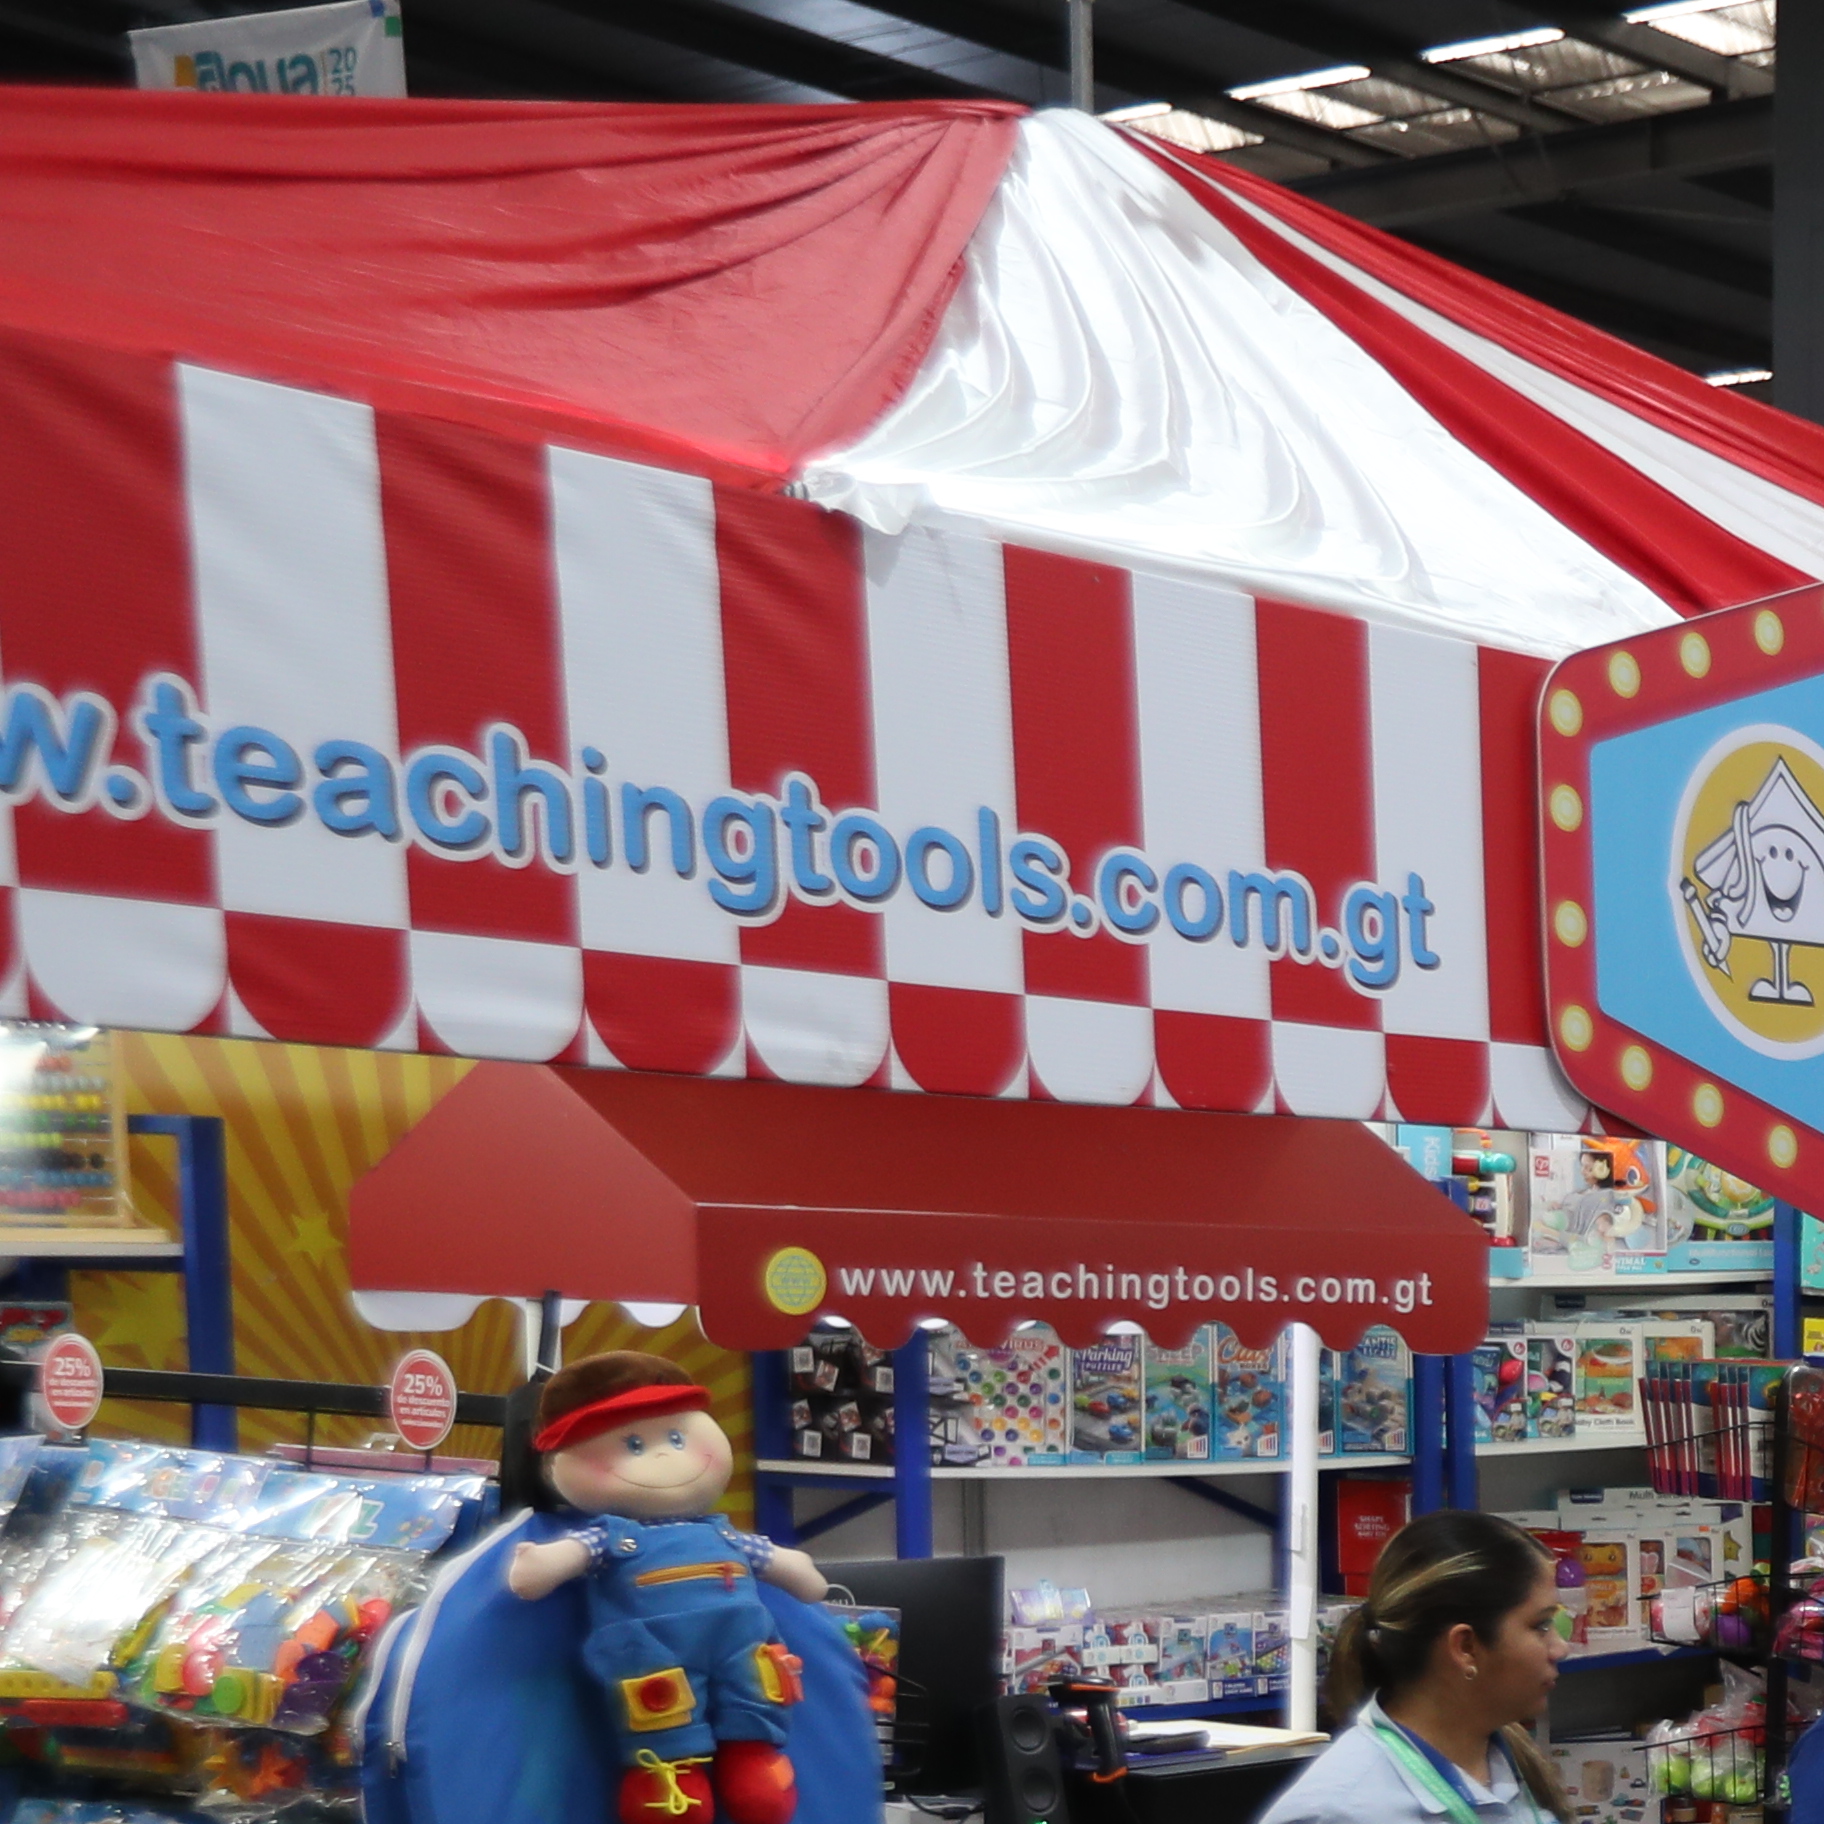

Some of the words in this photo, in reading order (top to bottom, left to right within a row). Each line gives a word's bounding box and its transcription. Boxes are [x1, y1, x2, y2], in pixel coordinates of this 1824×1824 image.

[332, 47, 358, 76] 20
[840, 1261, 1433, 1311] www.teachingtools.com.gt
[53, 1357, 92, 1378] 25%
[1082, 1347, 1132, 1369] Parking
[404, 1373, 443, 1396] 25%
